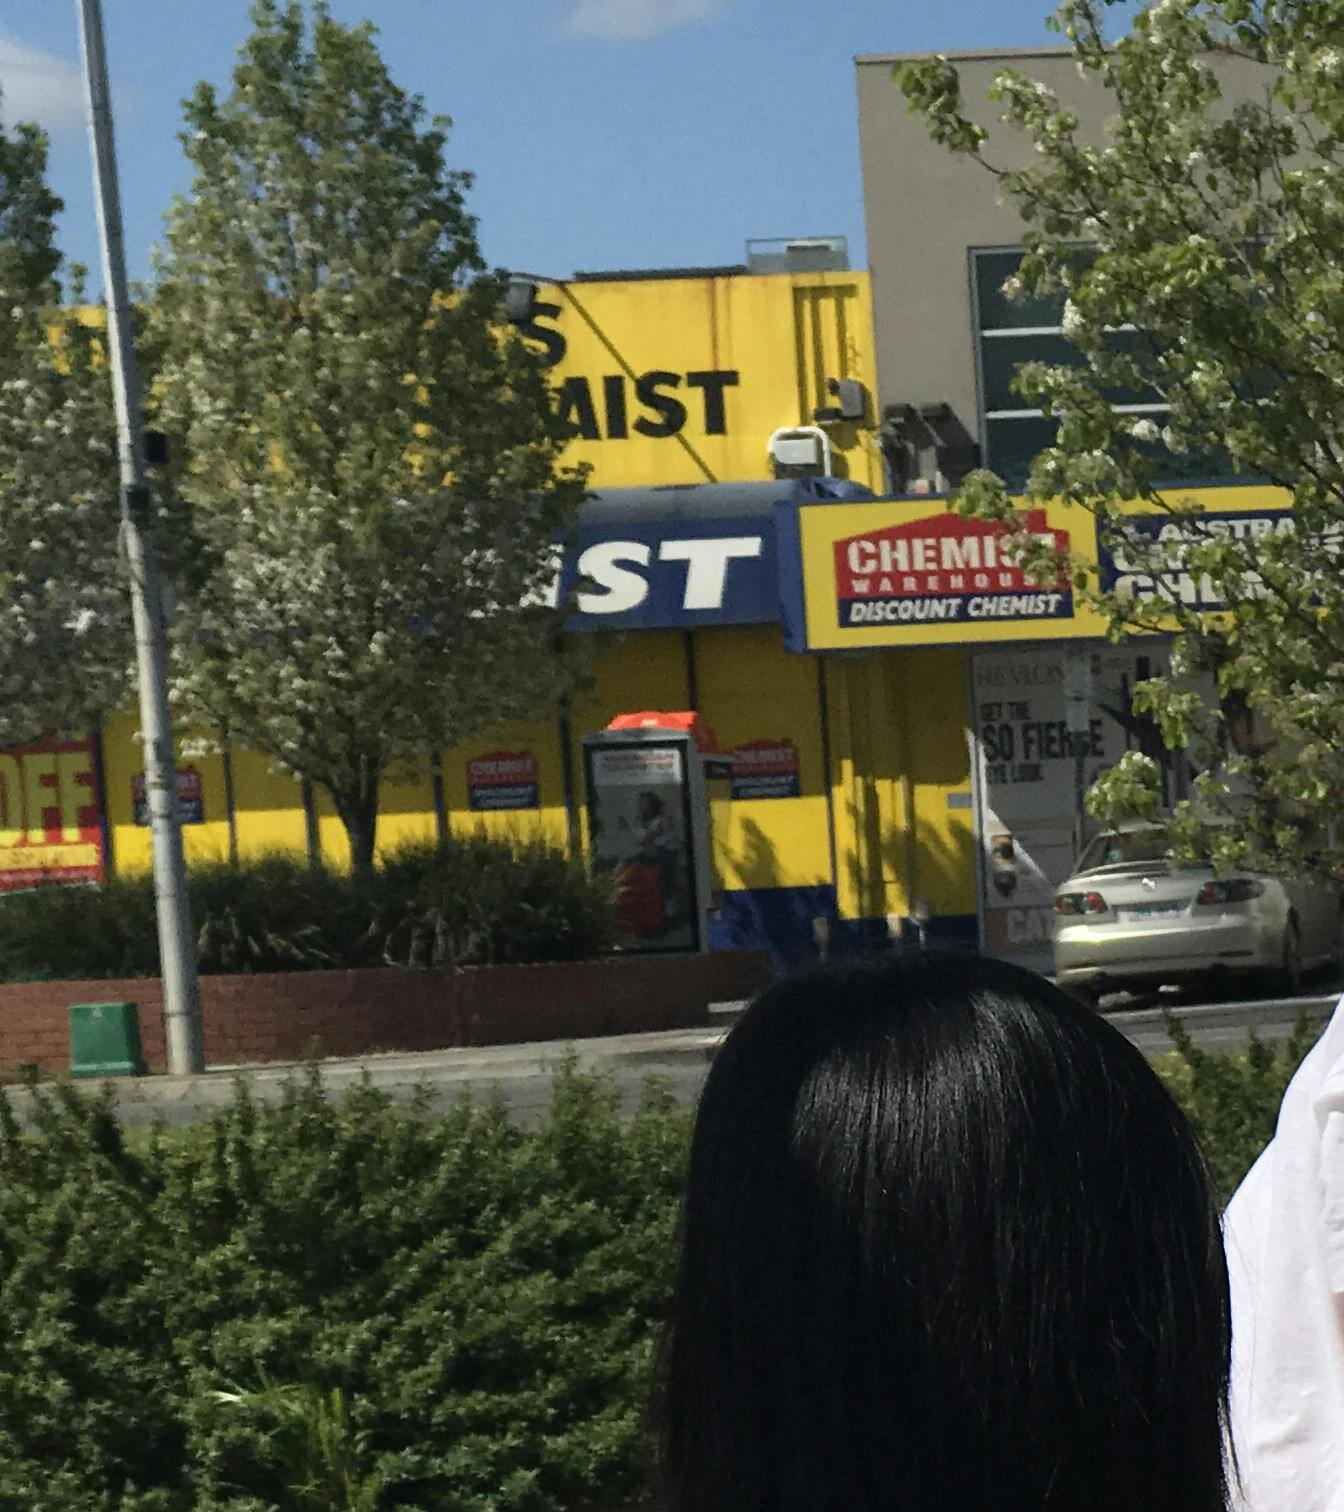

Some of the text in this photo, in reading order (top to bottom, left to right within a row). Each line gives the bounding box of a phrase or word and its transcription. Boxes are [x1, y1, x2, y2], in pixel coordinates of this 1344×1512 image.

[851, 573, 1057, 594] WAREHOU
[850, 593, 1063, 623] DISCOUNT CHEMIST
[982, 722, 1015, 762] SO
